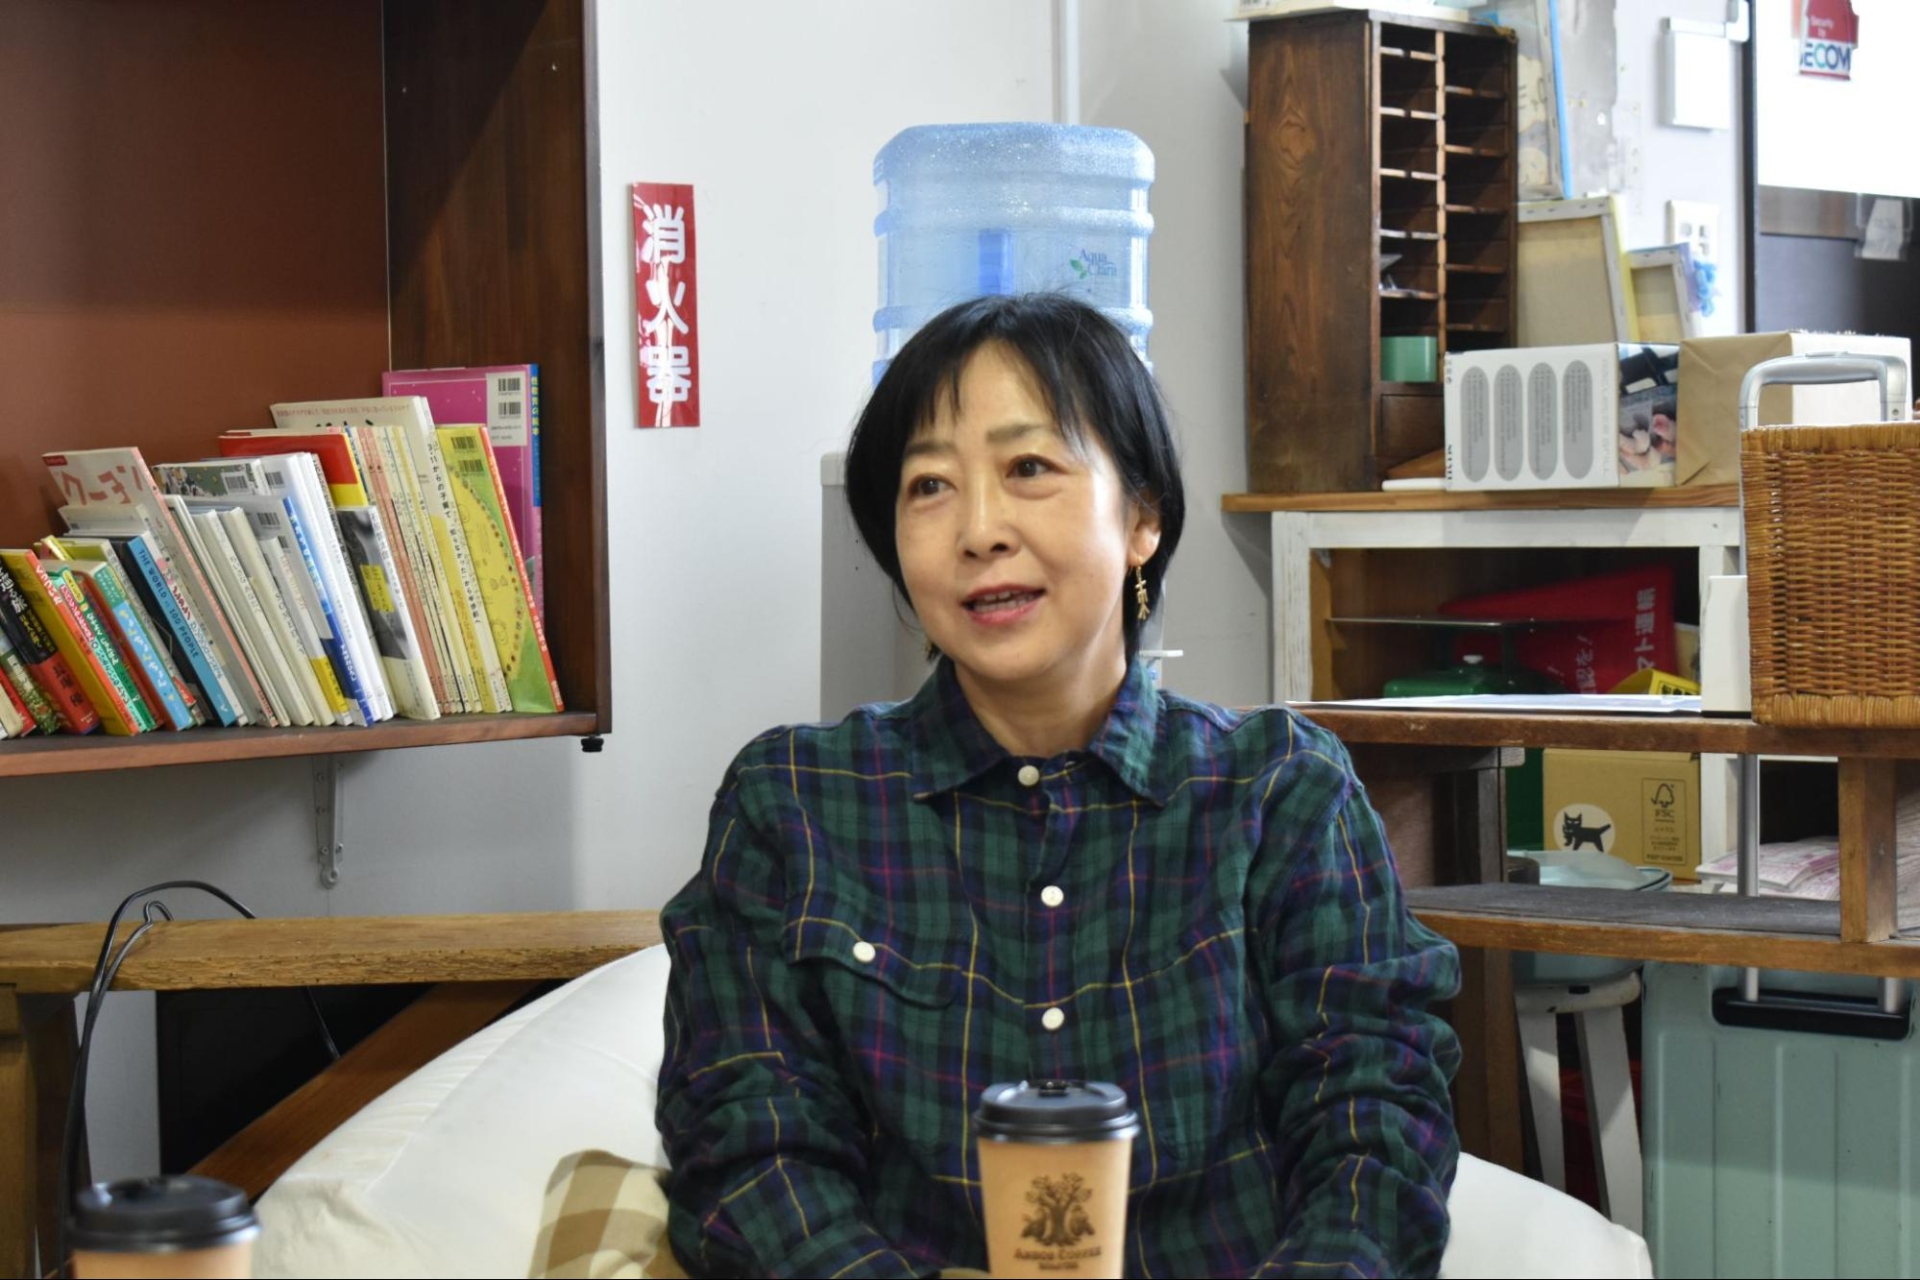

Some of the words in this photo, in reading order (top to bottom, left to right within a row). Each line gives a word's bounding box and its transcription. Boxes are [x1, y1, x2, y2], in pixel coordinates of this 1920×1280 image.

[640, 202, 693, 404] 消火器
[148, 567, 167, 599] WORLD
[169, 607, 179, 625] 100
[178, 625, 200, 659] PEOPLE
[1654, 809, 1675, 818] FSC
